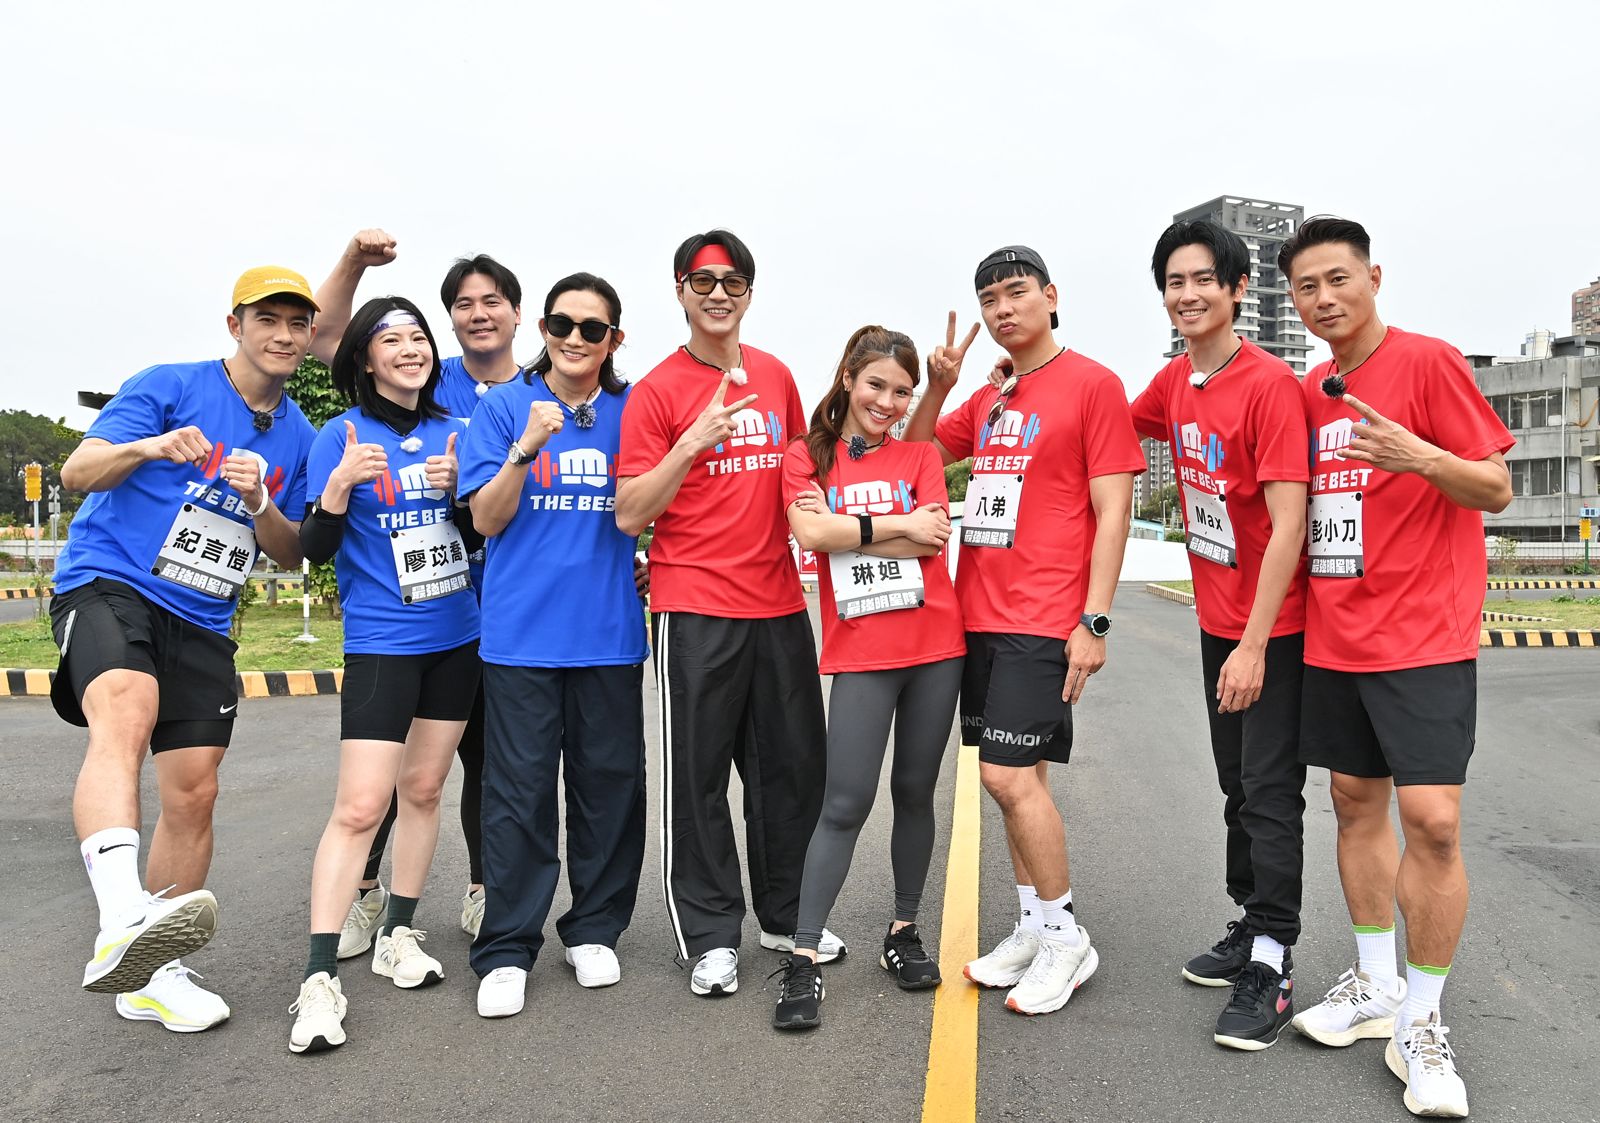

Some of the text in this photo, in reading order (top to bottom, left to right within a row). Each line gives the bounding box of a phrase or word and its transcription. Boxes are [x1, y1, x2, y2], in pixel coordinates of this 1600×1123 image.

[706, 453, 784, 476] THE BEST
[972, 455, 1033, 471] HE BEST
[1178, 464, 1228, 494] HE BEST
[1311, 468, 1374, 492] HE BEST
[184, 480, 254, 519] THE BE
[530, 495, 616, 512] THE BES
[975, 495, 1006, 518] 八弟
[376, 507, 448, 529] THE BE
[1195, 505, 1223, 532] Max
[1312, 518, 1356, 543] 彭小刀
[172, 527, 250, 572] 紀言愷
[964, 529, 1009, 546] 最強明星隊
[1189, 536, 1230, 563] 最強明星隊
[403, 540, 463, 574] 廖苡喬
[1311, 558, 1357, 574] 最強明星隊
[160, 562, 234, 597] 最強明星隊
[851, 560, 902, 586] 琳妲
[411, 574, 468, 600] 最強明星隊
[846, 591, 918, 616] 最強明星隊
